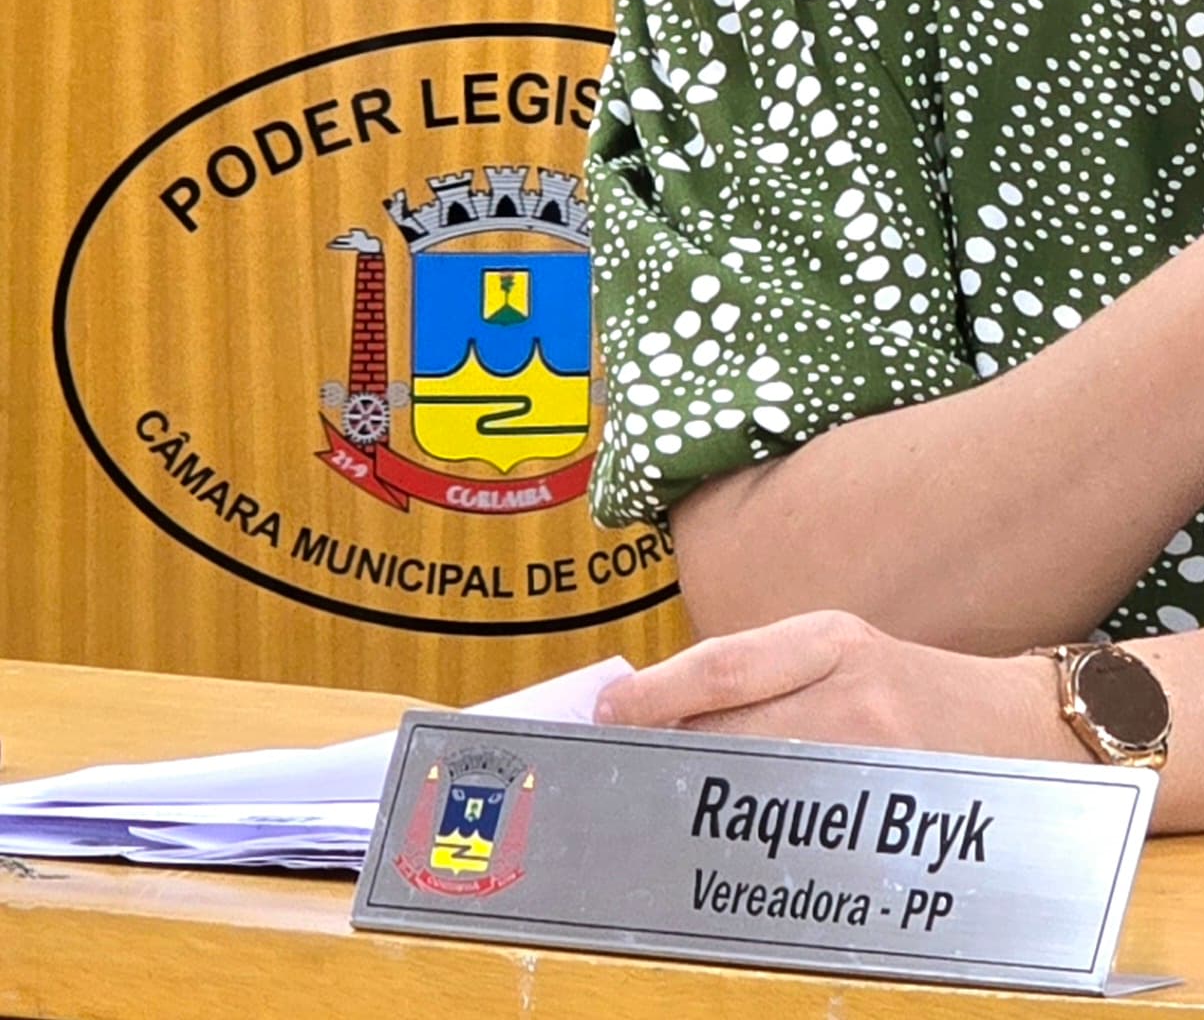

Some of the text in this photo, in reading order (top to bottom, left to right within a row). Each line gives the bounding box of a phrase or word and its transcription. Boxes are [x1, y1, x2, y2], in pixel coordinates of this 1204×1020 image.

[159, 87, 402, 233] PODER
[135, 409, 281, 548] CÂMARA
[291, 527, 513, 598] MUNICIPAL
[526, 558, 577, 596] DE
[691, 776, 995, 874] Raquel Bryk
[692, 868, 871, 927] Vereadora
[901, 888, 954, 931] PP
